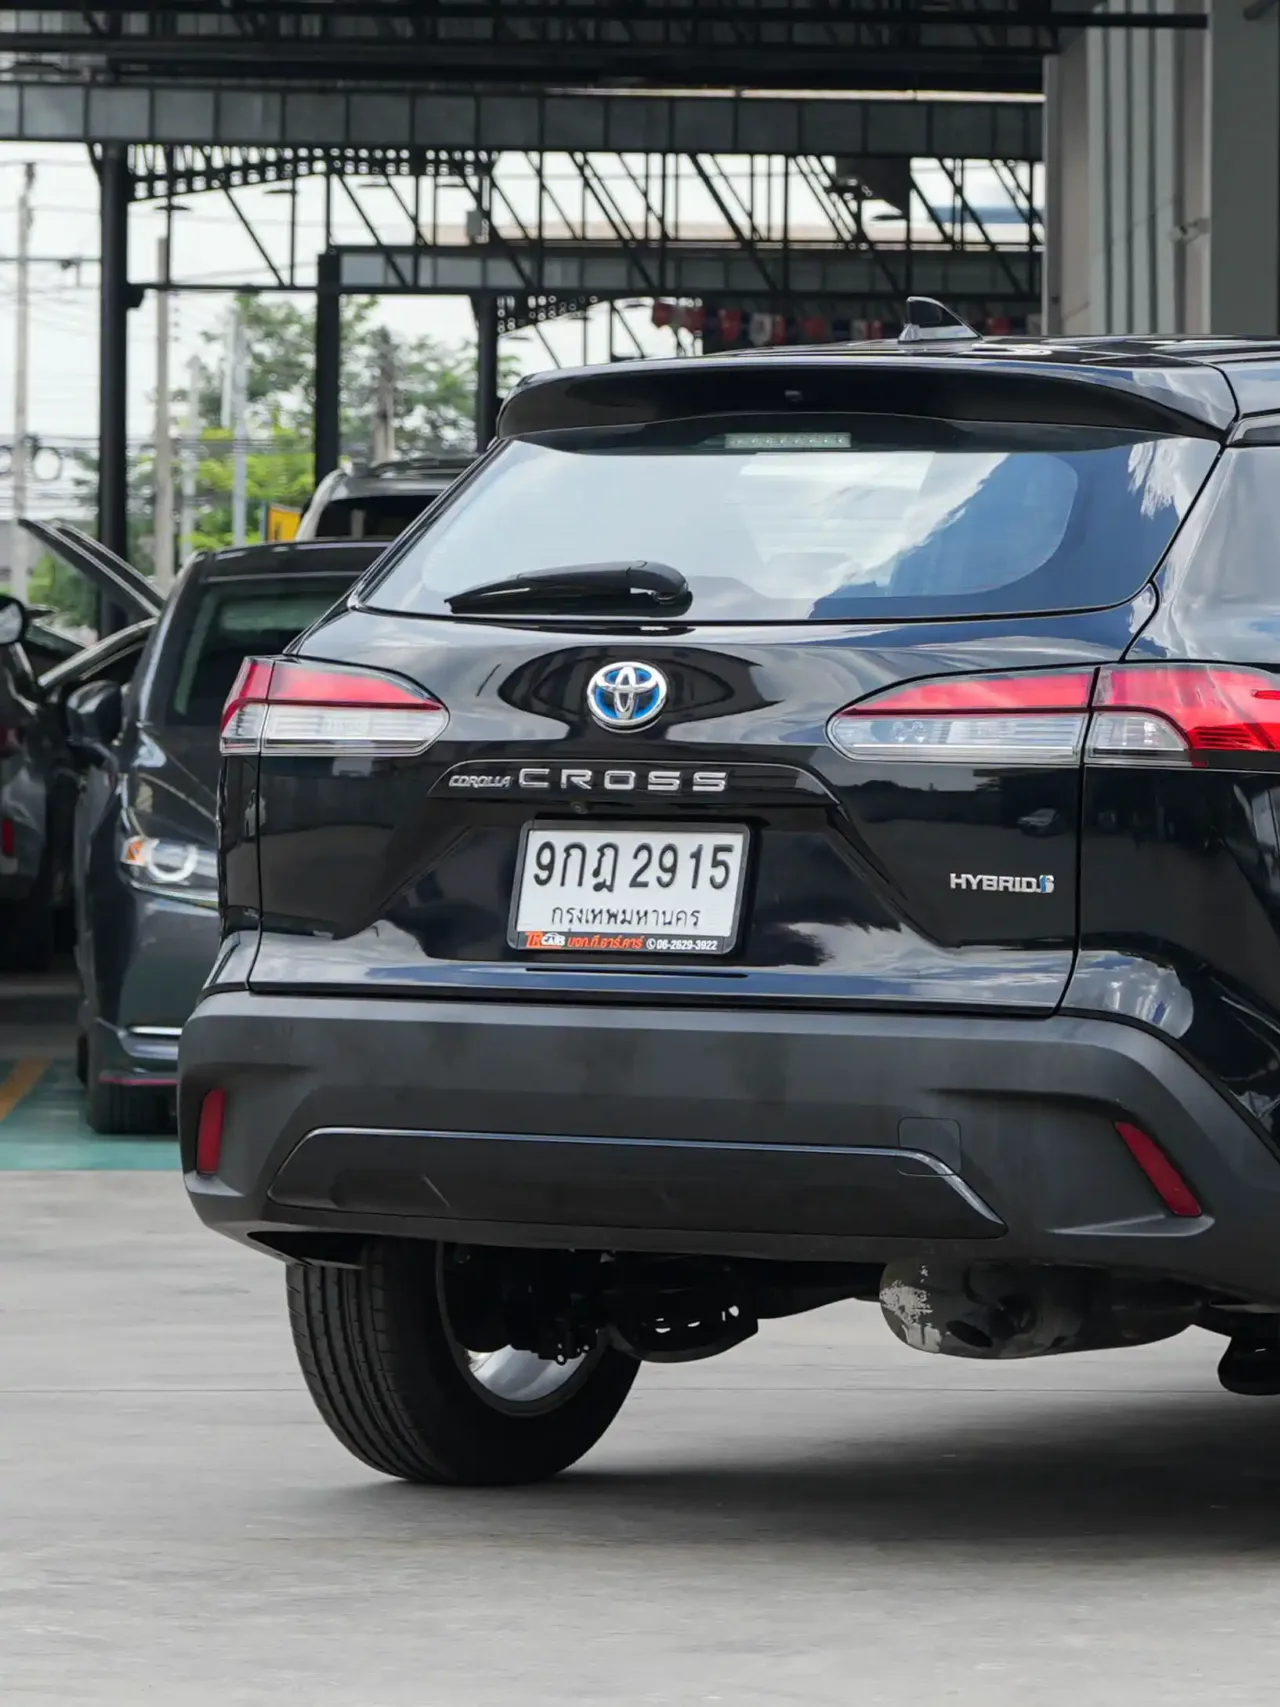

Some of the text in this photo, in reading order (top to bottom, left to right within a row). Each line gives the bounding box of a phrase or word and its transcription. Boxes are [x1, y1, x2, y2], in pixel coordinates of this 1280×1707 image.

[449, 768, 727, 791] COROLLA CROSS
[533, 841, 735, 892] 9กฎ 2915
[949, 873, 1037, 893] HYBRID
